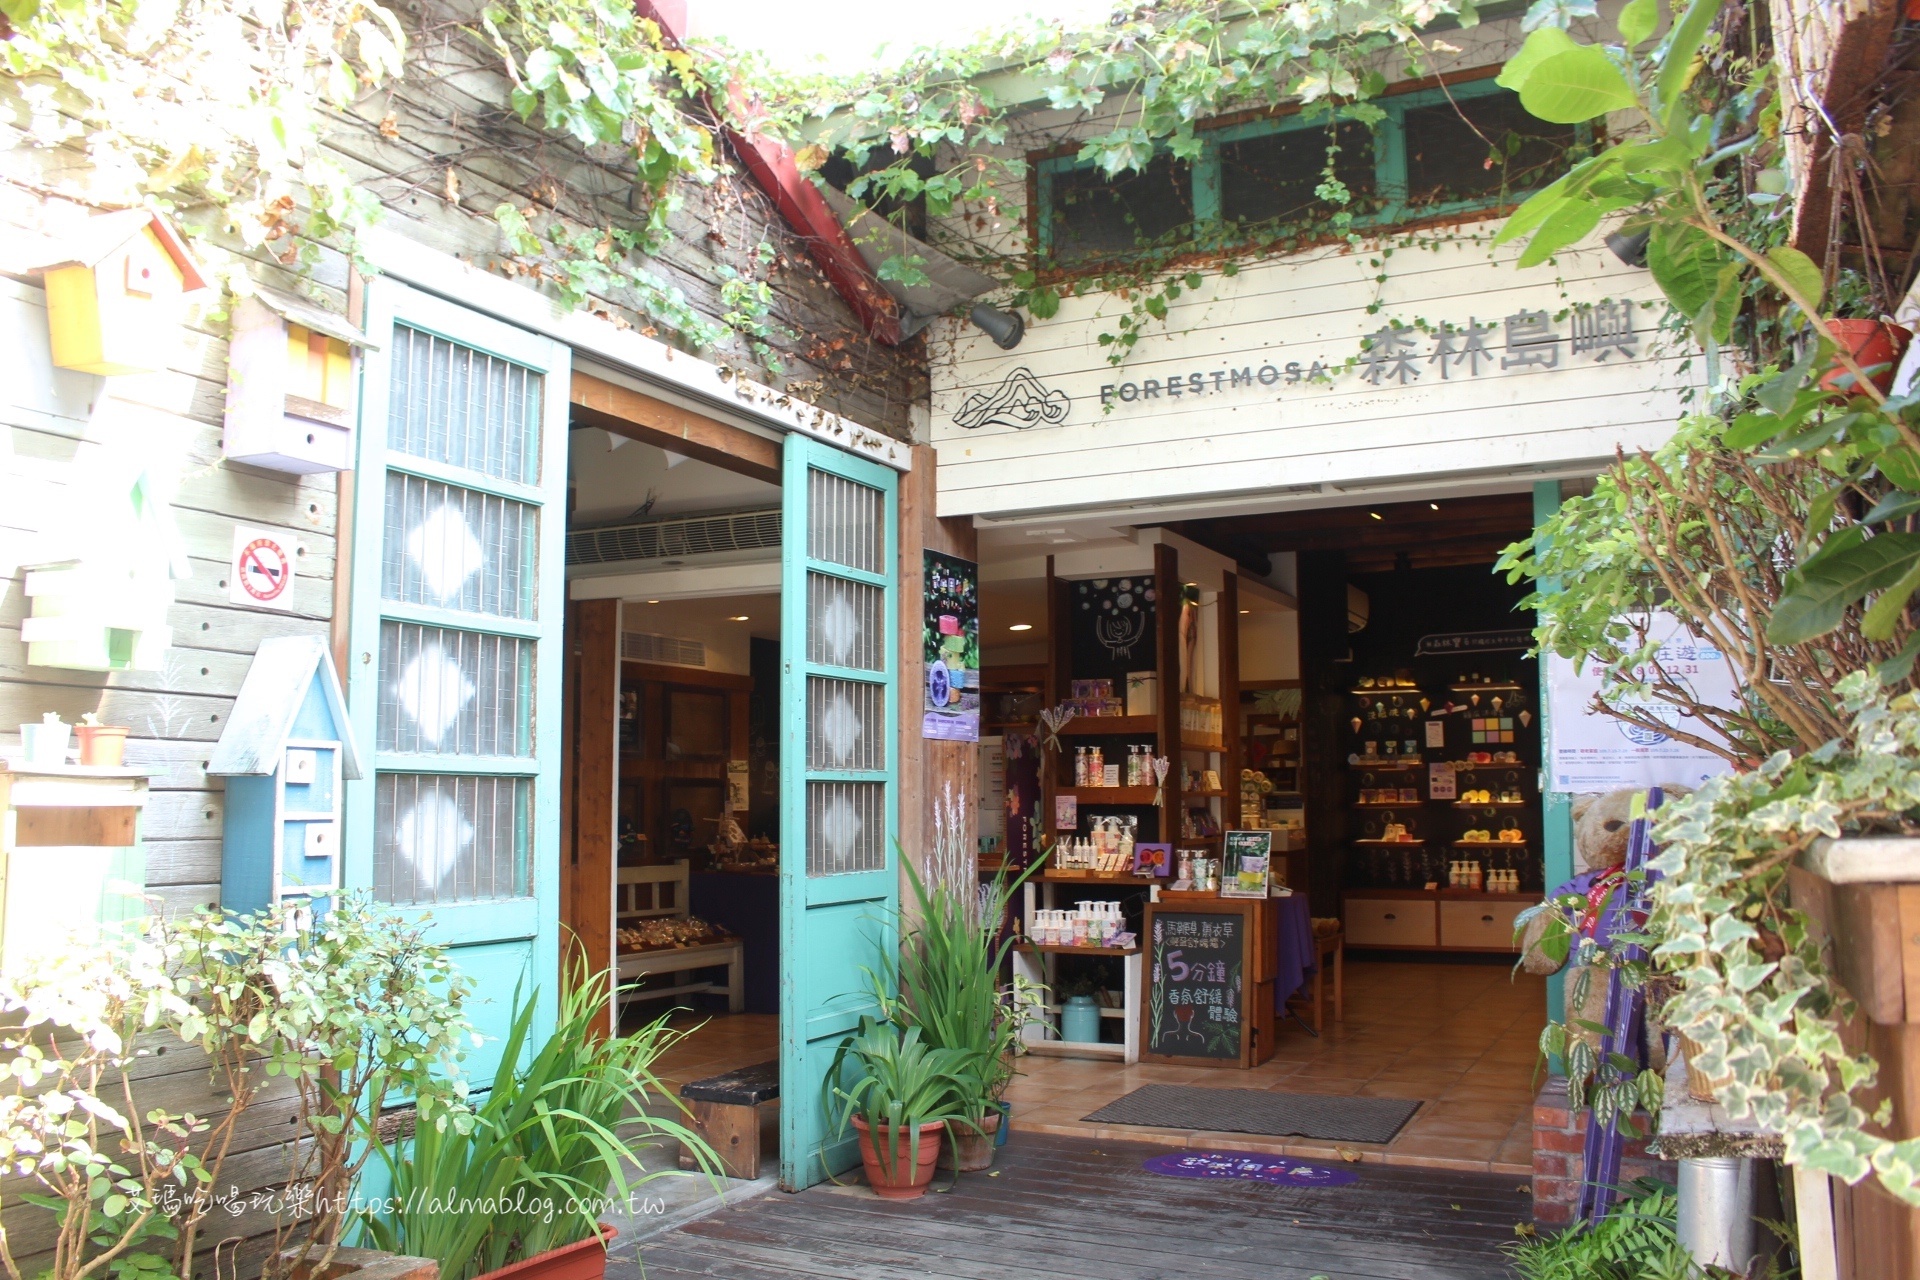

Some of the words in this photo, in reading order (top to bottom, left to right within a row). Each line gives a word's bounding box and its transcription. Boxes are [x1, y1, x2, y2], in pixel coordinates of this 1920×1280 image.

[1100, 361, 1326, 404] FORESTMOSA
[1360, 298, 1639, 386] 森林島嶼
[1168, 987, 1223, 1005] 香氛舒緩
[1207, 1005, 1238, 1023] 體驗
